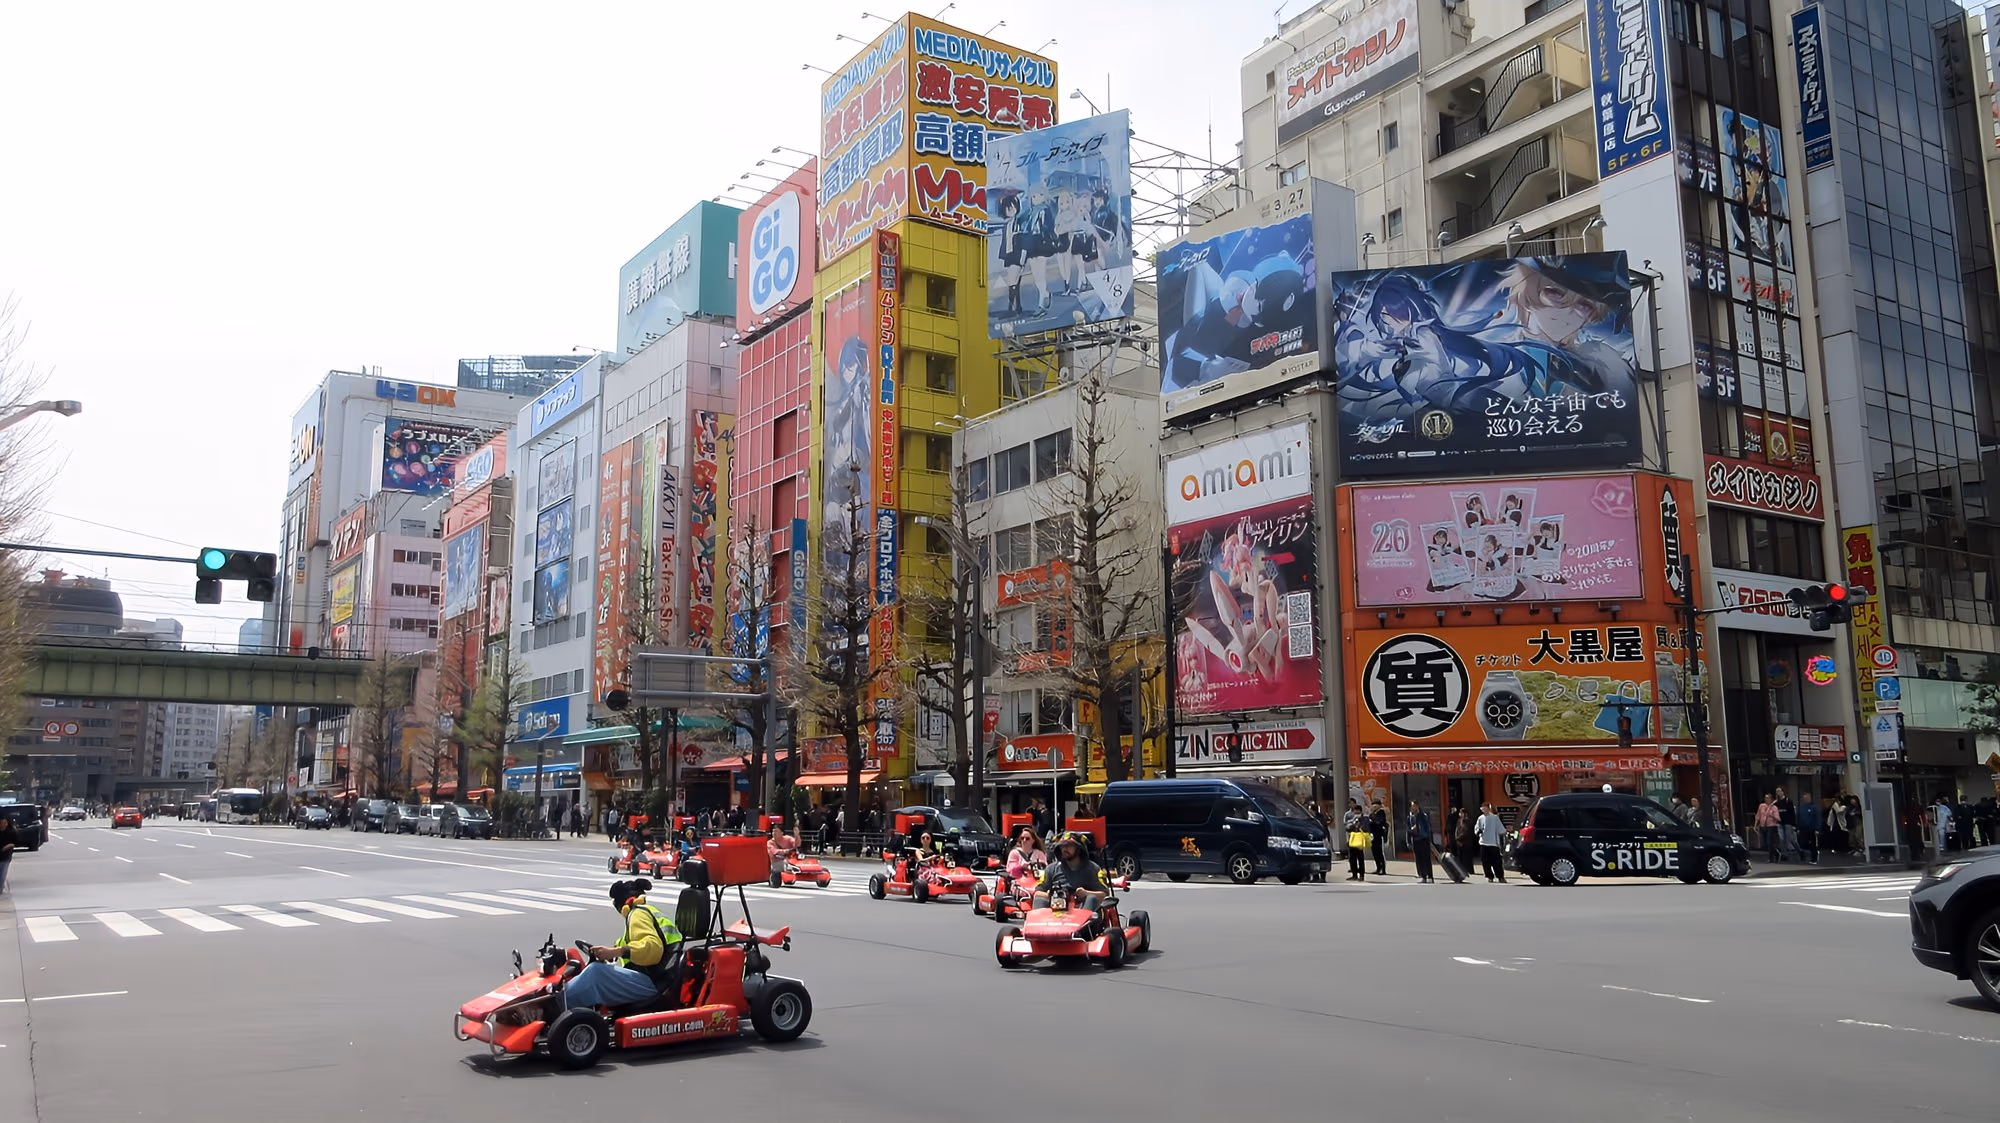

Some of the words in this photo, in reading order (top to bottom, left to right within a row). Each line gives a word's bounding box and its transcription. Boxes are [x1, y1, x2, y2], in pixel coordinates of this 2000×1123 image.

[1287, 18, 1406, 110] メイドカジノ
[916, 61, 1054, 132] 激安販売
[1484, 389, 1627, 416] どんな宇宙でも
[1486, 415, 1584, 438] 巡り会える
[1181, 447, 1294, 501] amiami
[1707, 460, 1818, 513] メイドカジノ
[1868, 601, 1883, 638] TAX
[1474, 653, 1522, 667] チケット
[1527, 626, 1646, 665] 大黒屋
[1852, 604, 1874, 692] 면세점
[1213, 731, 1263, 752] CMIC
[1265, 731, 1288, 750] ZIN
[1591, 850, 1680, 870] S.RIDE
[631, 1025, 660, 1039] Street
